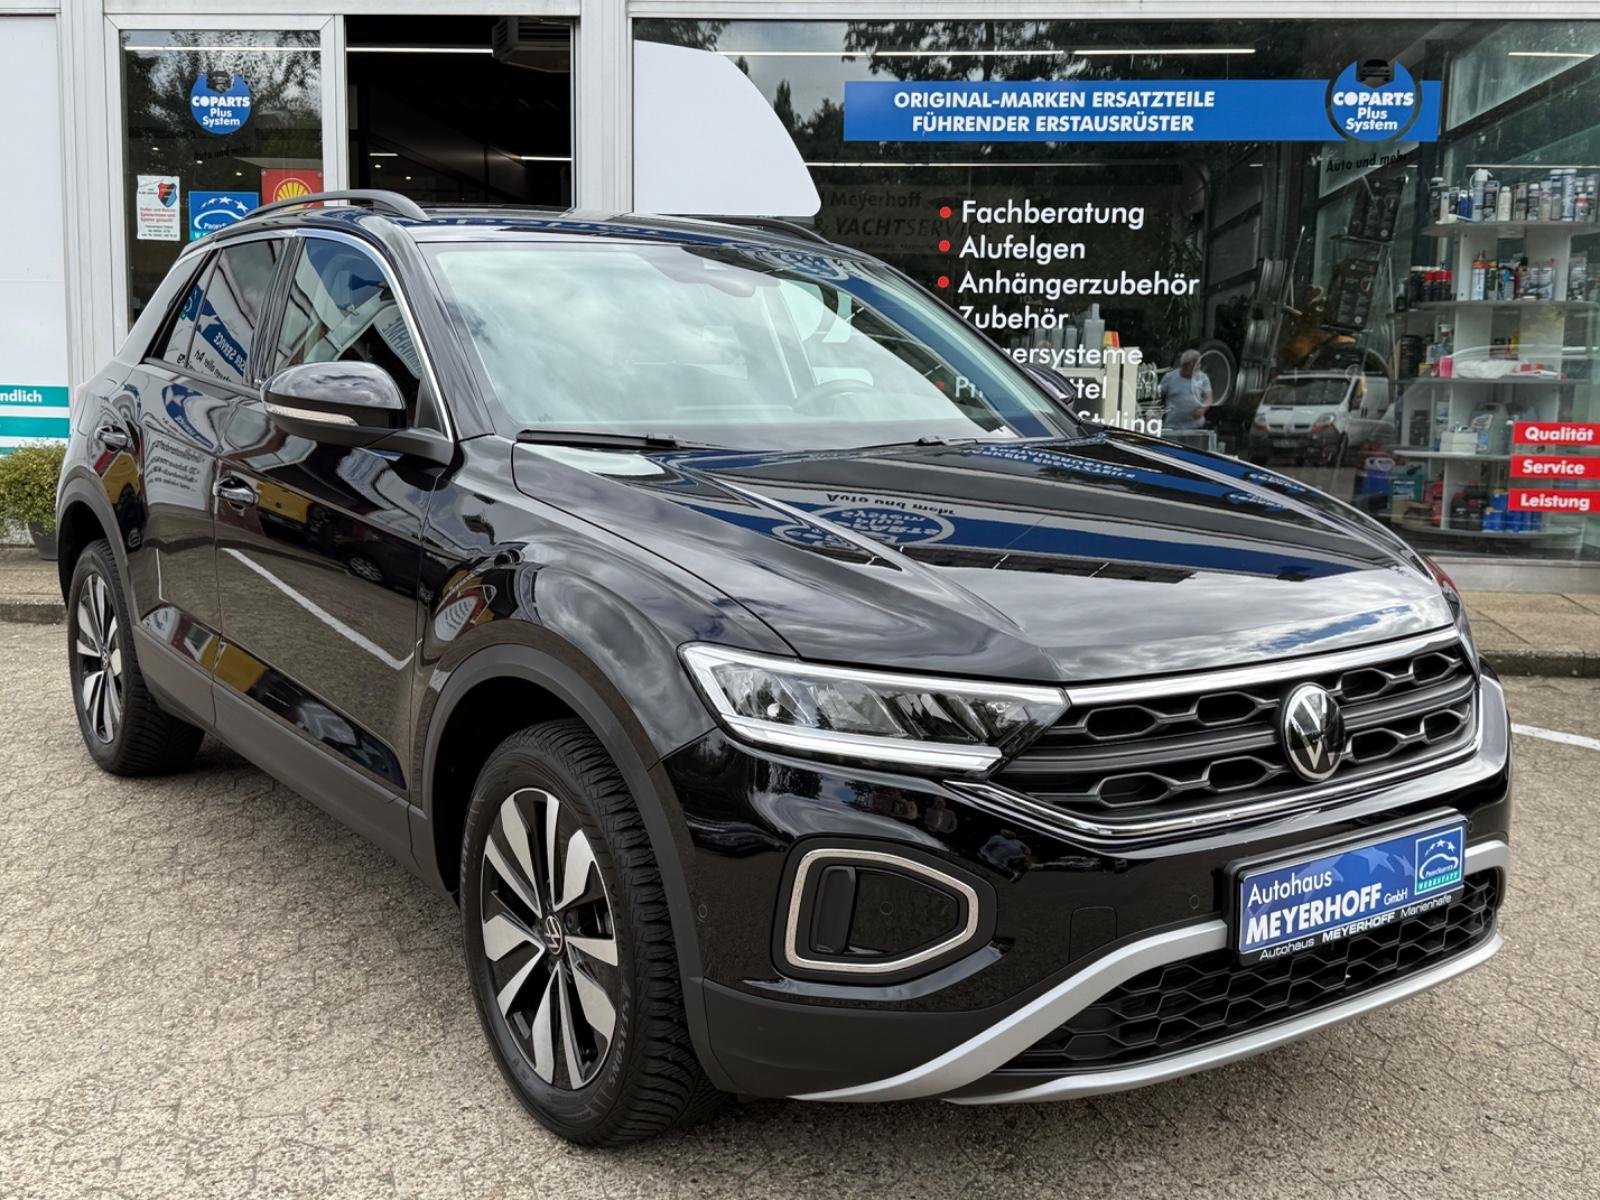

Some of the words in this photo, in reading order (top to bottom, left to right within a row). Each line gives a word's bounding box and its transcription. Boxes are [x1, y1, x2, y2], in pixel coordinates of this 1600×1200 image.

[192, 96, 250, 107] COPARTS
[894, 92, 1085, 108] ORIGINAL-MARKEN
[1092, 91, 1215, 108] ERSATZTEILE
[1333, 92, 1414, 106] COPARTS
[202, 116, 240, 127] System
[210, 108, 232, 117] Plus
[912, 111, 1030, 132] FÜHRENDER
[1035, 111, 1194, 132] ERSTAUSRÜSTER
[1357, 107, 1388, 119] Plus
[1345, 118, 1398, 133] System
[1326, 160, 1352, 173] Auto
[1356, 153, 1377, 167] und
[830, 192, 922, 212] Meyerhoff
[961, 199, 1145, 230] Fachberatung
[958, 234, 1086, 265] Alufelgen
[957, 270, 1200, 300] Anhängerzubehör
[1525, 426, 1594, 441] Qualität
[1522, 459, 1585, 475] Service
[1520, 493, 1591, 511] Leistung
[1247, 871, 1333, 908] Autohaus
[1245, 882, 1383, 945] MEYERHOFF
[1384, 887, 1409, 906] GmbH
[1259, 938, 1316, 961] Autohaus
[1321, 911, 1396, 944] MEYERHOFF
[1401, 894, 1453, 919] Marienhafe
